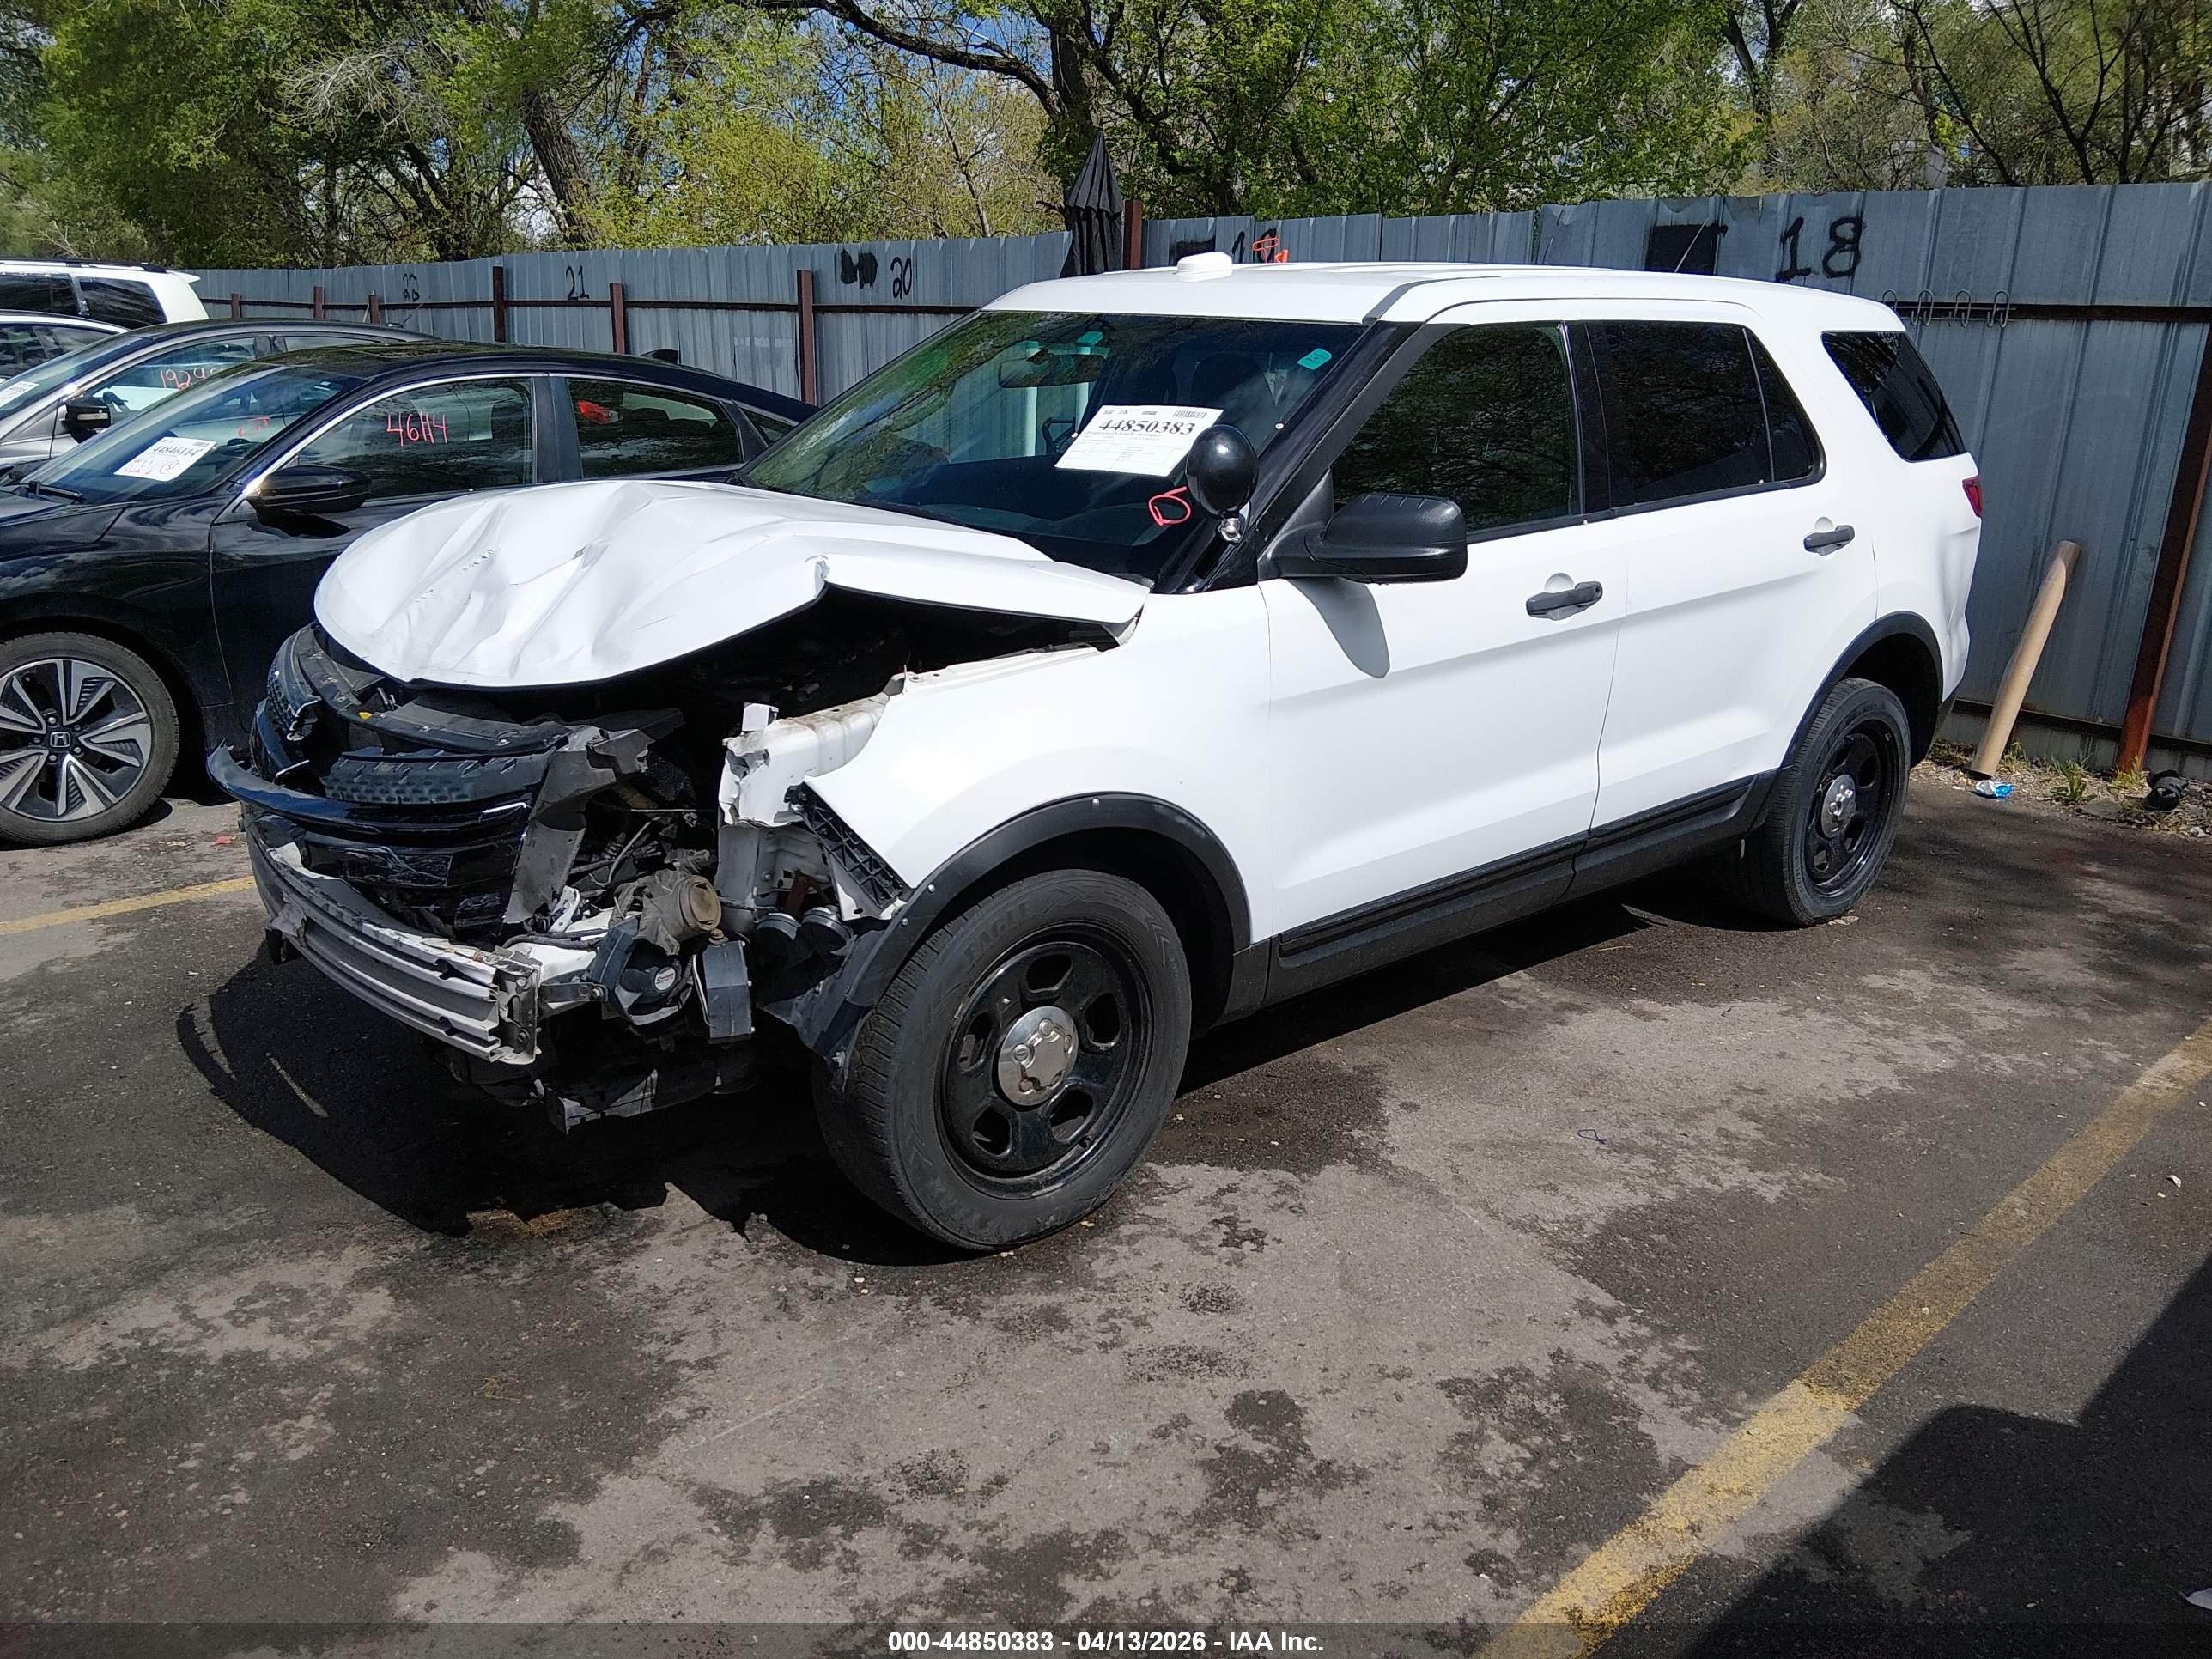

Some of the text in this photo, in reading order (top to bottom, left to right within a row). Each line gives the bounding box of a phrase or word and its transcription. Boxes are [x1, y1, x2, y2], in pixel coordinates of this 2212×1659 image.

[1775, 216, 1863, 283] 18
[565, 265, 590, 301] 21
[890, 256, 912, 301] 20
[1098, 418, 1196, 435] 44850383
